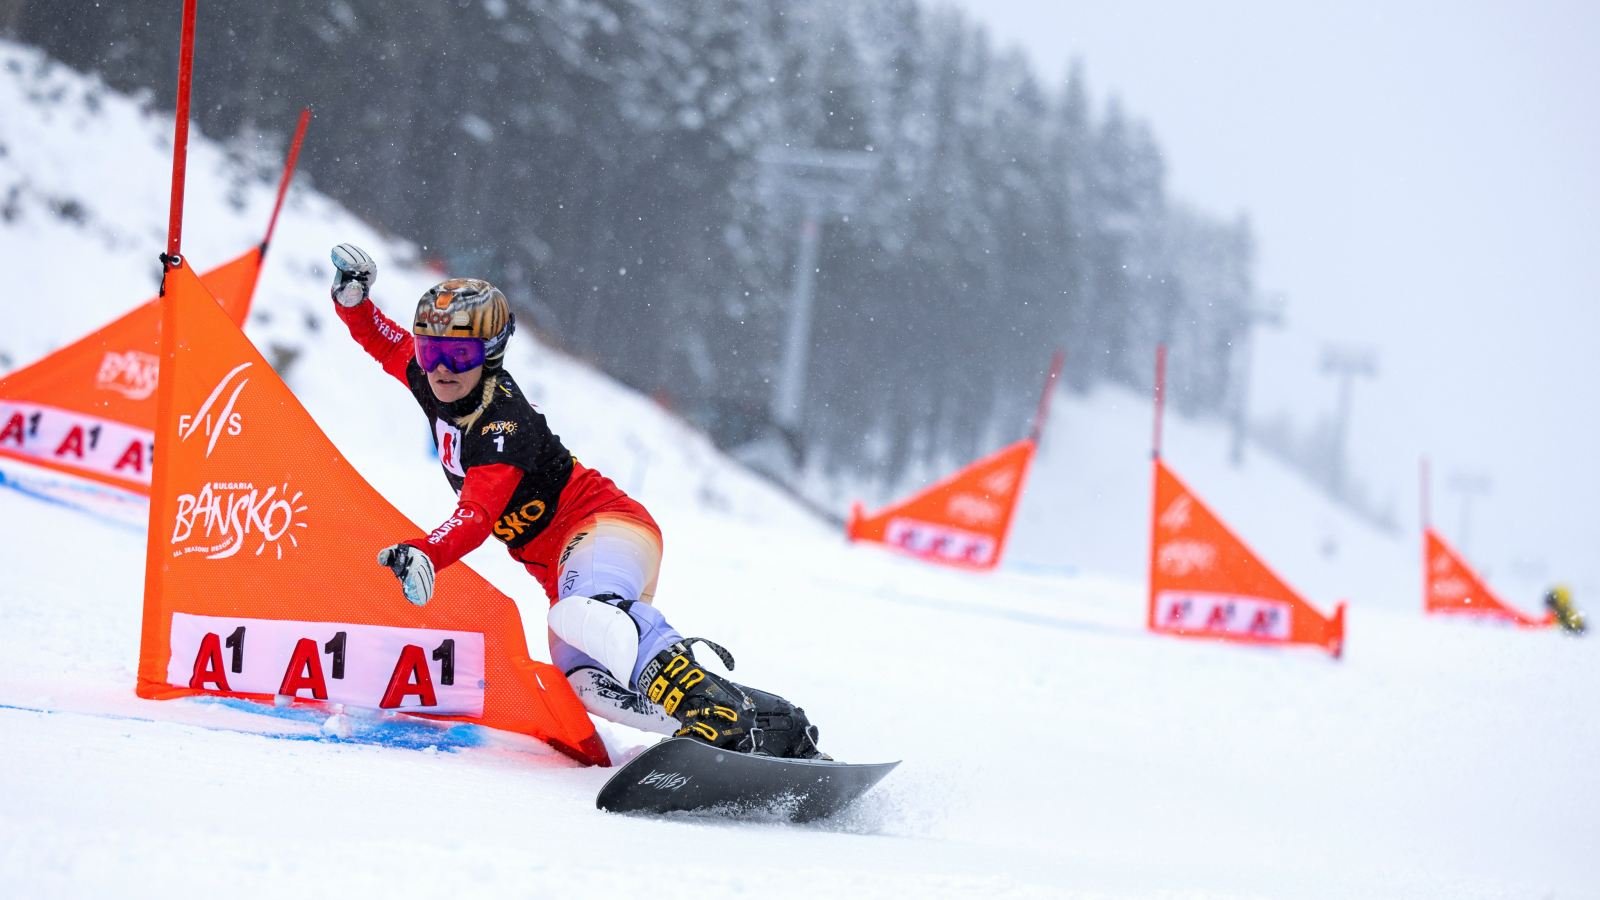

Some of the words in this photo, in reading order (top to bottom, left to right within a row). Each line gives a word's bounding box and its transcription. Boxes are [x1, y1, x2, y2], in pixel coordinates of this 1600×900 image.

[54, 422, 102, 461] A1
[178, 413, 242, 437] FIS
[493, 435, 505, 452] 1
[213, 482, 253, 490] BULGARIA
[171, 481, 293, 559] BANSKO
[493, 499, 546, 542] SKO
[189, 626, 246, 692] A1
[278, 631, 347, 700] A1
[379, 638, 456, 709] A1
